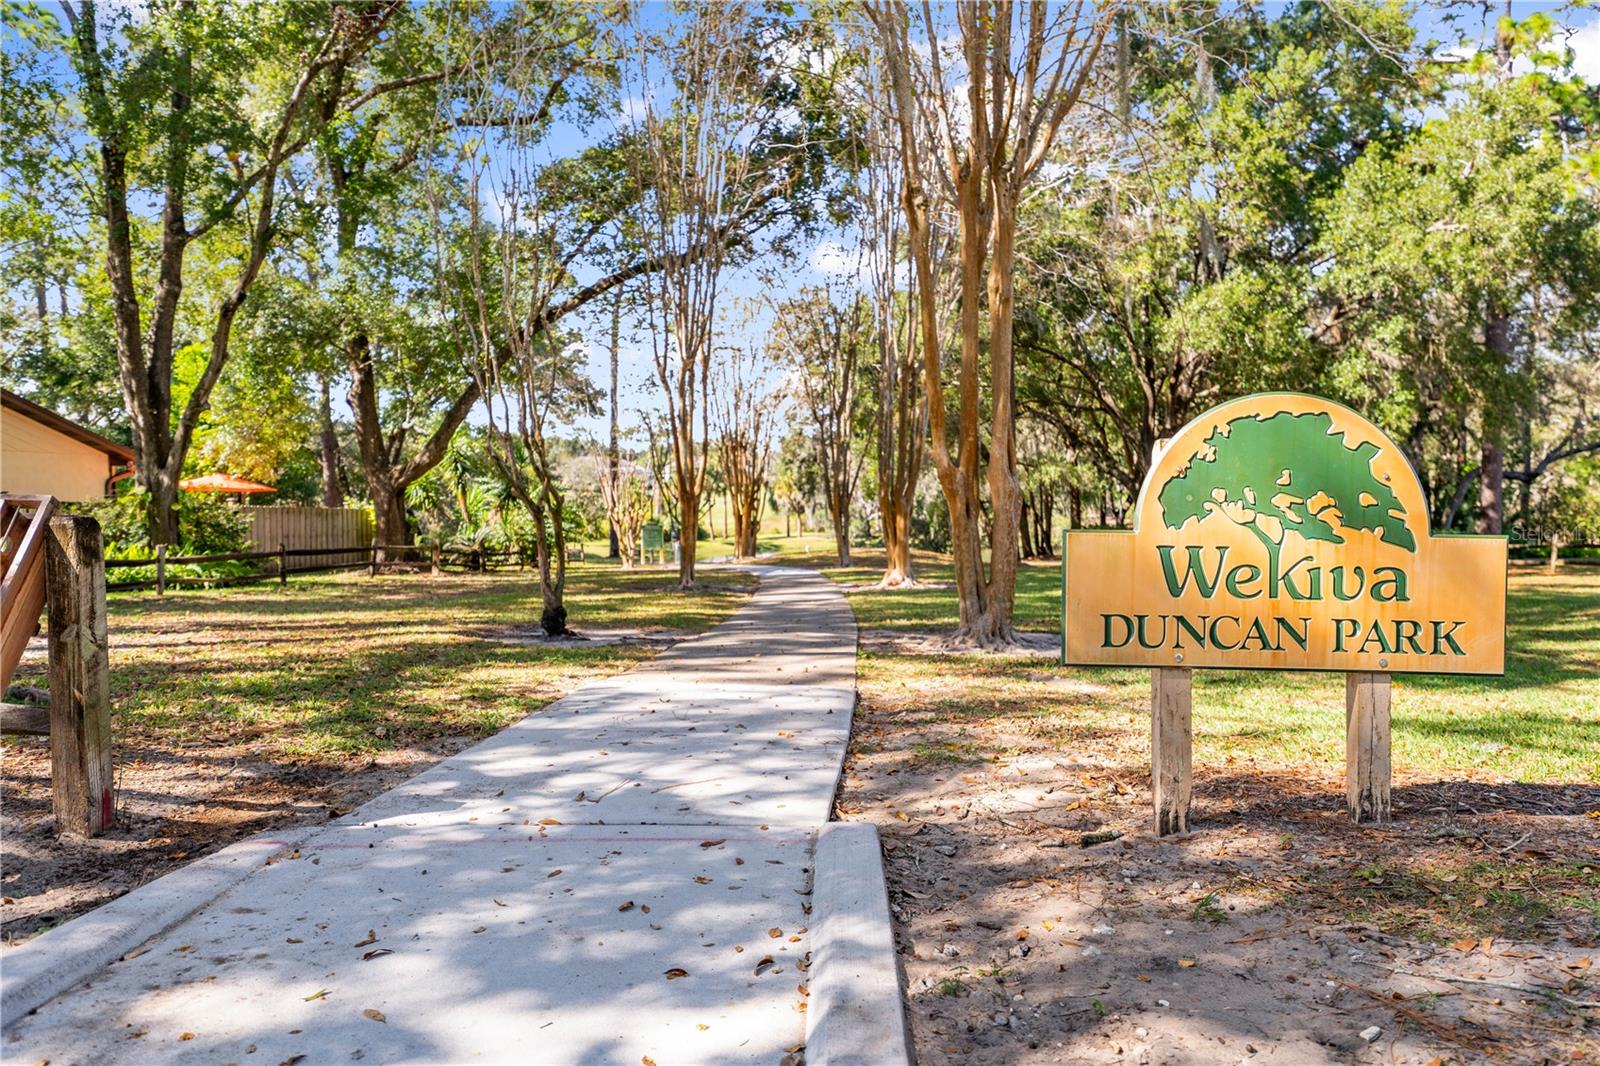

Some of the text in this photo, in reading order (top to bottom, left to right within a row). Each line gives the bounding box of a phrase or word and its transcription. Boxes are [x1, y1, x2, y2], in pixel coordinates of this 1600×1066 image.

[1155, 544, 1411, 602] Wekiva
[1100, 613, 1467, 656] DUNCAN PARK
